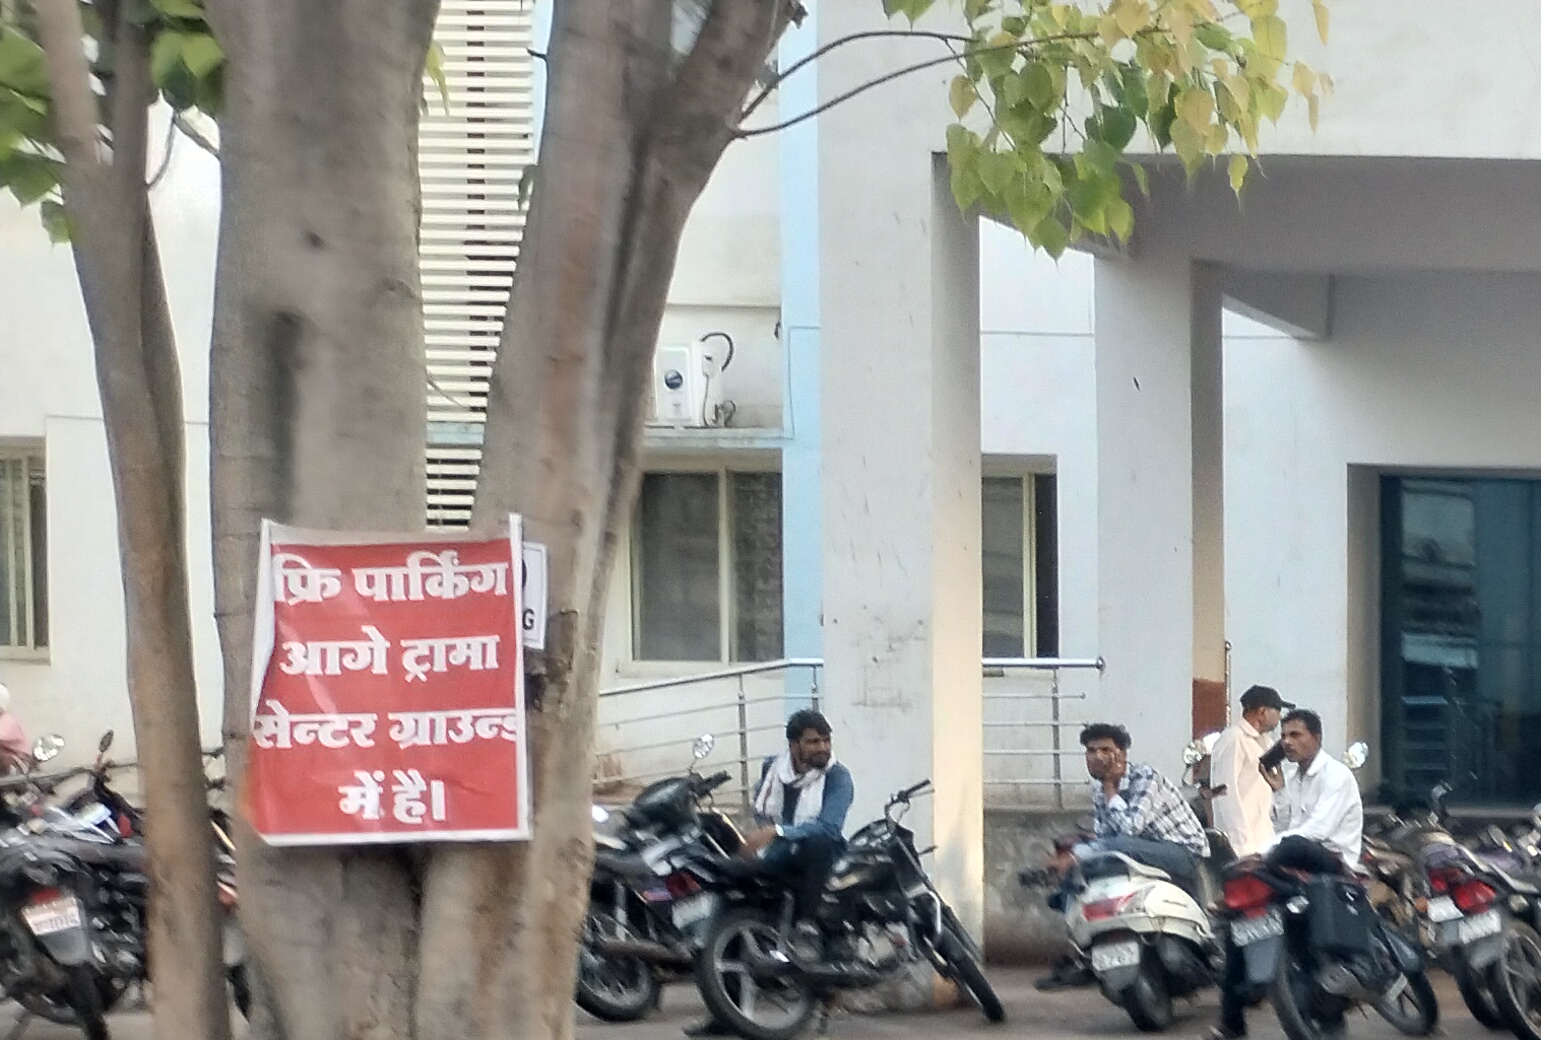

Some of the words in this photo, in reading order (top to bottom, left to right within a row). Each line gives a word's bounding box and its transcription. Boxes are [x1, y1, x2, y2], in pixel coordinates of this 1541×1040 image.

[351, 549, 509, 602] पार्किंग
[279, 625, 391, 676] आगे
[400, 634, 500, 682] ट्रामा
[253, 699, 377, 749] सेन्टर
[338, 769, 385, 820] में
